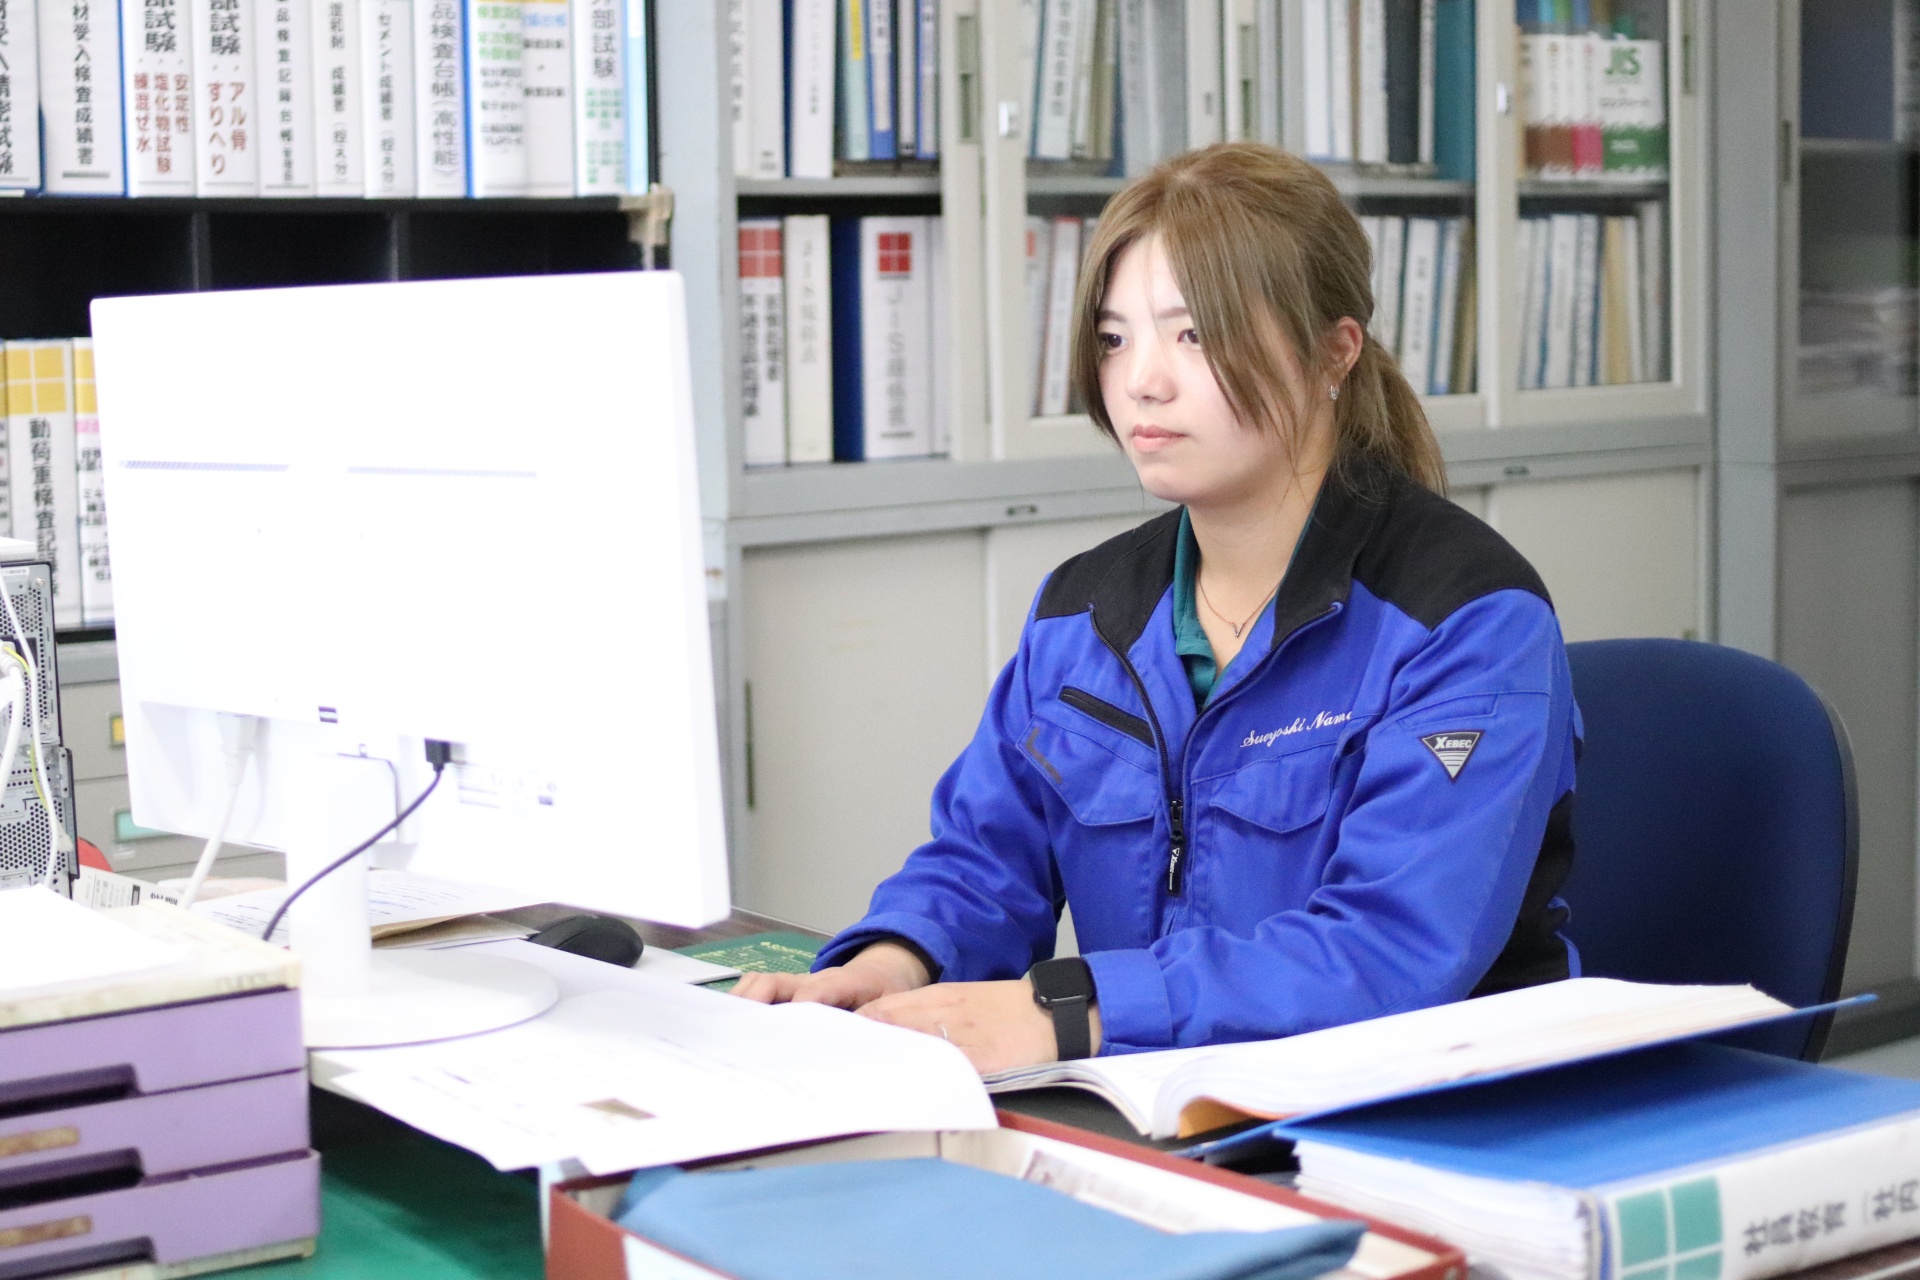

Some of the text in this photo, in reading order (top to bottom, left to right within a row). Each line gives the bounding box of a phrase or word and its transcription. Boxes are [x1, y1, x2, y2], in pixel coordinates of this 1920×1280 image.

[1605, 46, 1640, 76] JIS
[72, 0, 94, 166] 材受入検査成績書
[1433, 736, 1474, 749] XEBEC
